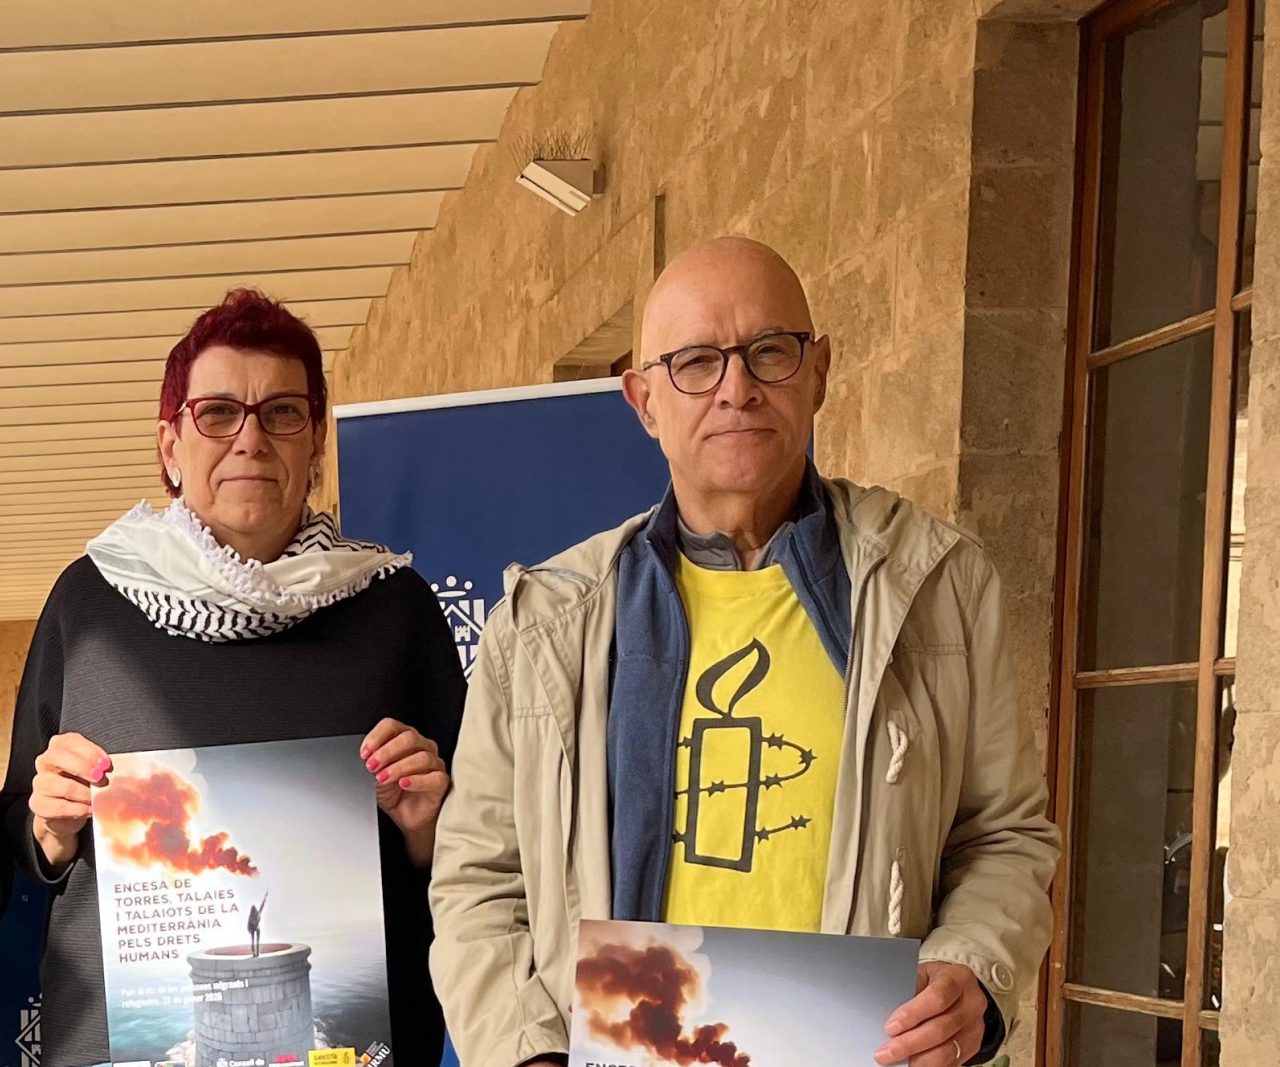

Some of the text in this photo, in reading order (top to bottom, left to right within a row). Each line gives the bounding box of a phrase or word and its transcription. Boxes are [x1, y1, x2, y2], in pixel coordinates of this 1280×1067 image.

[114, 879, 192, 894] ENCESA DE
[177, 889, 235, 902] TALAIES
[125, 906, 192, 920] TALAIOTS
[198, 905, 215, 915] DE
[221, 903, 239, 913] LA
[118, 918, 221, 935] MEDITERRÀNIA
[118, 934, 200, 949] PELS DRETS
[120, 950, 179, 963] HUMANS
[255, 1058, 265, 1066] de
